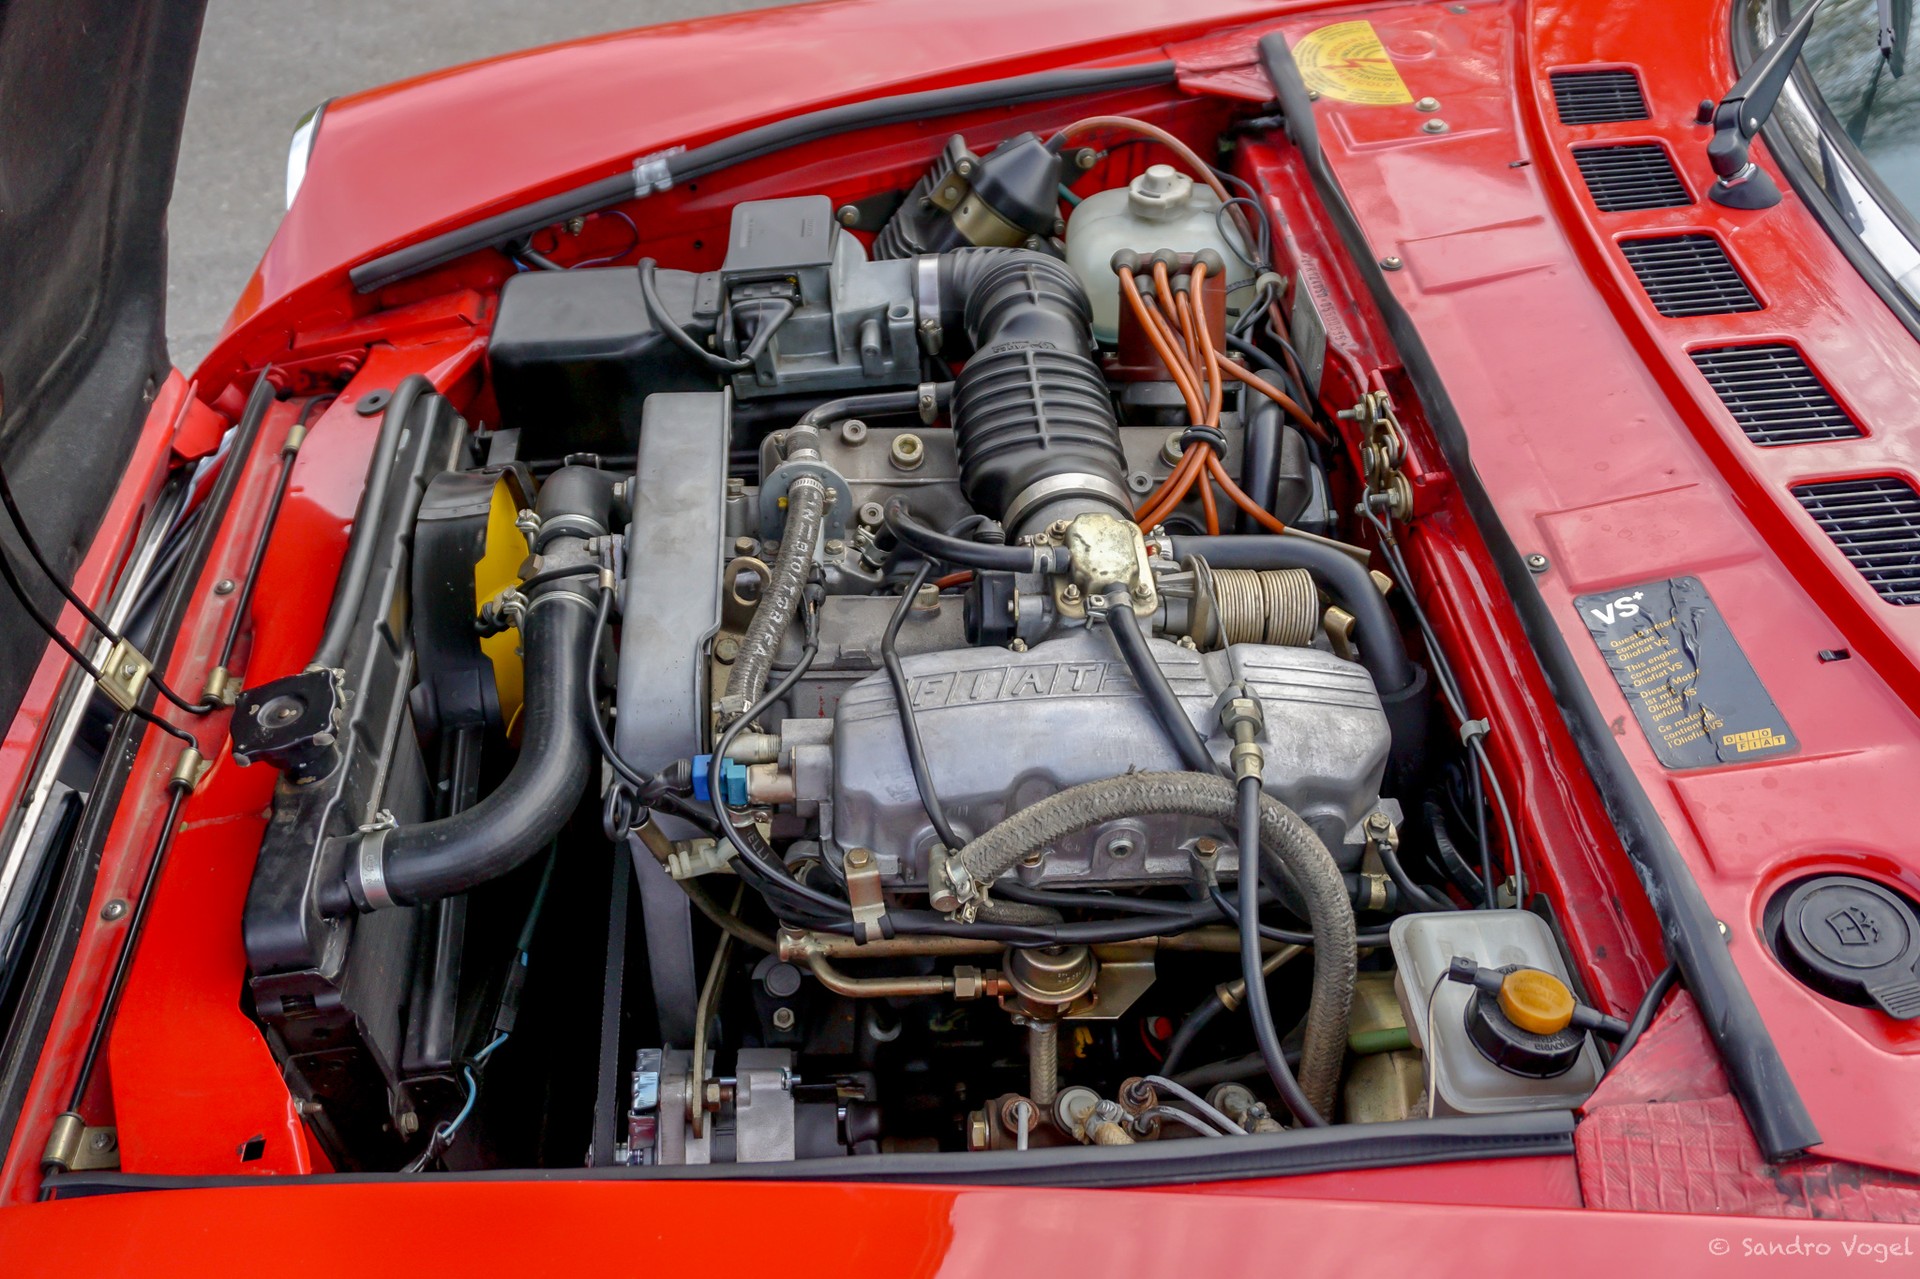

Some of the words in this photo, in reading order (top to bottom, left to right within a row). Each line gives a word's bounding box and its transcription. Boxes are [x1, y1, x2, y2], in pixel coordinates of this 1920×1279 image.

[1610, 630, 1644, 648] Questo
[1616, 635, 1655, 655] contiene
[1619, 644, 1653, 661] Oliofiat
[1625, 661, 1646, 673] This
[1648, 648, 1679, 664] engine
[1630, 660, 1670, 680] contains
[1633, 669, 1668, 687] Oliofiat
[911, 664, 1098, 707] FIAT
[1644, 697, 1657, 706] ist
[1659, 688, 1676, 701] mit
[1648, 695, 1683, 713] Oliofiat
[1652, 704, 1683, 722] gefüllt
[1658, 725, 1672, 733] Ce
[1663, 720, 1702, 741] contient
[1724, 729, 1770, 744] OLIO
[1739, 736, 1783, 751] FIAT
